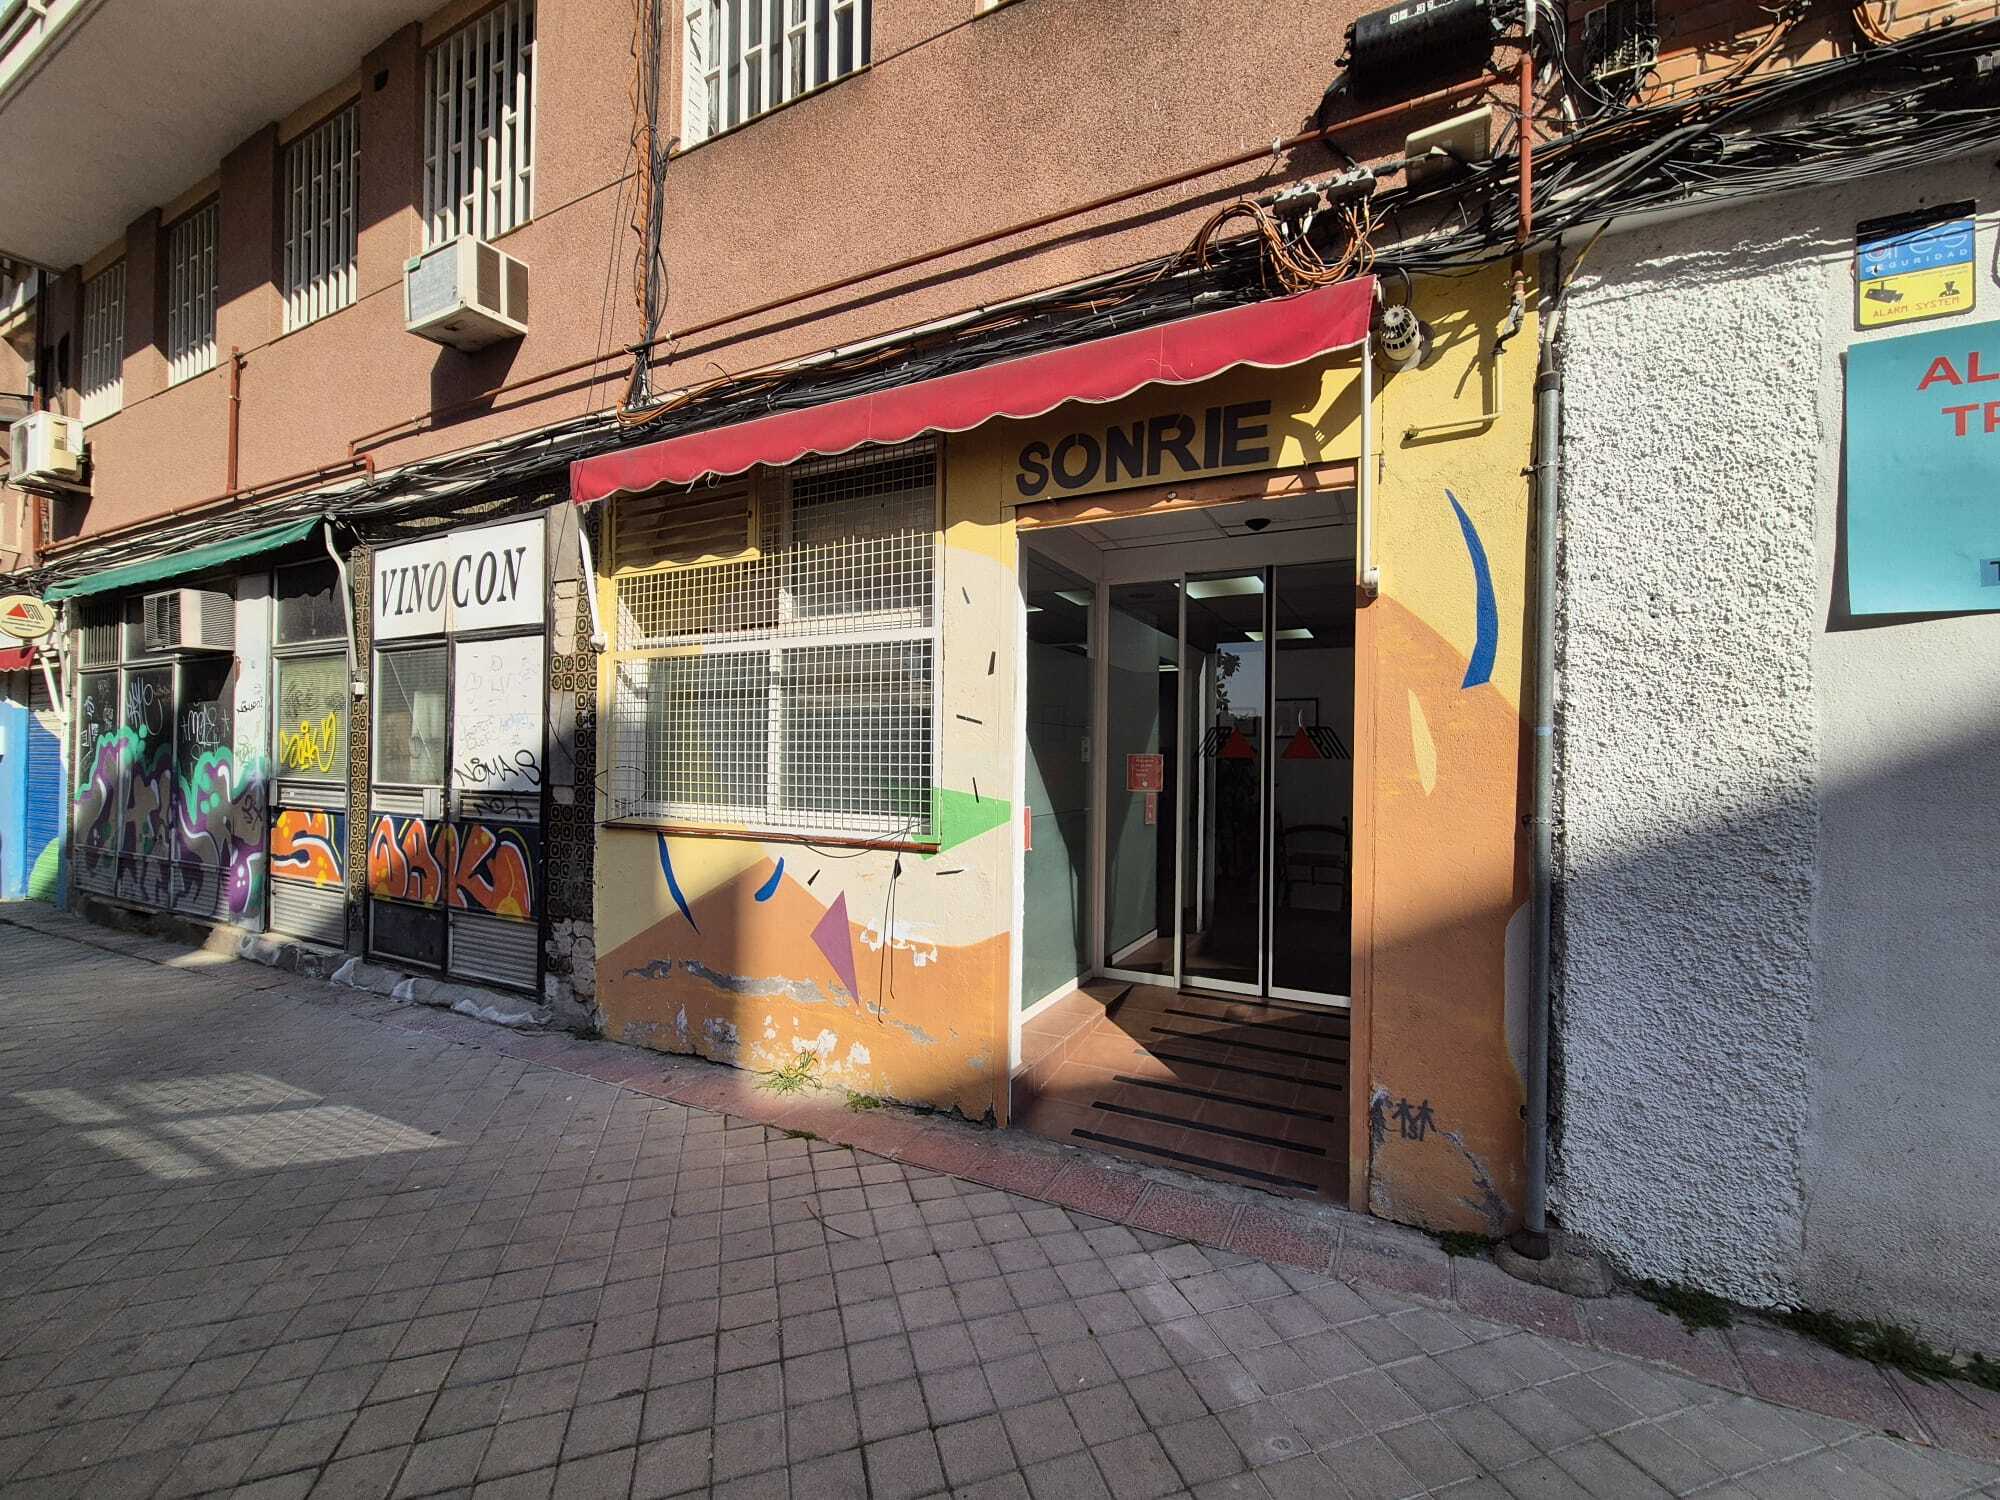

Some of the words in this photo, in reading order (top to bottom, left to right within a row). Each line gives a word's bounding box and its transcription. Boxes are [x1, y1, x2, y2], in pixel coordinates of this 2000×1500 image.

[1872, 305, 1909, 318] ALARM
[1915, 295, 1961, 312] SYSTEM
[1015, 400, 1272, 496] SONRIE
